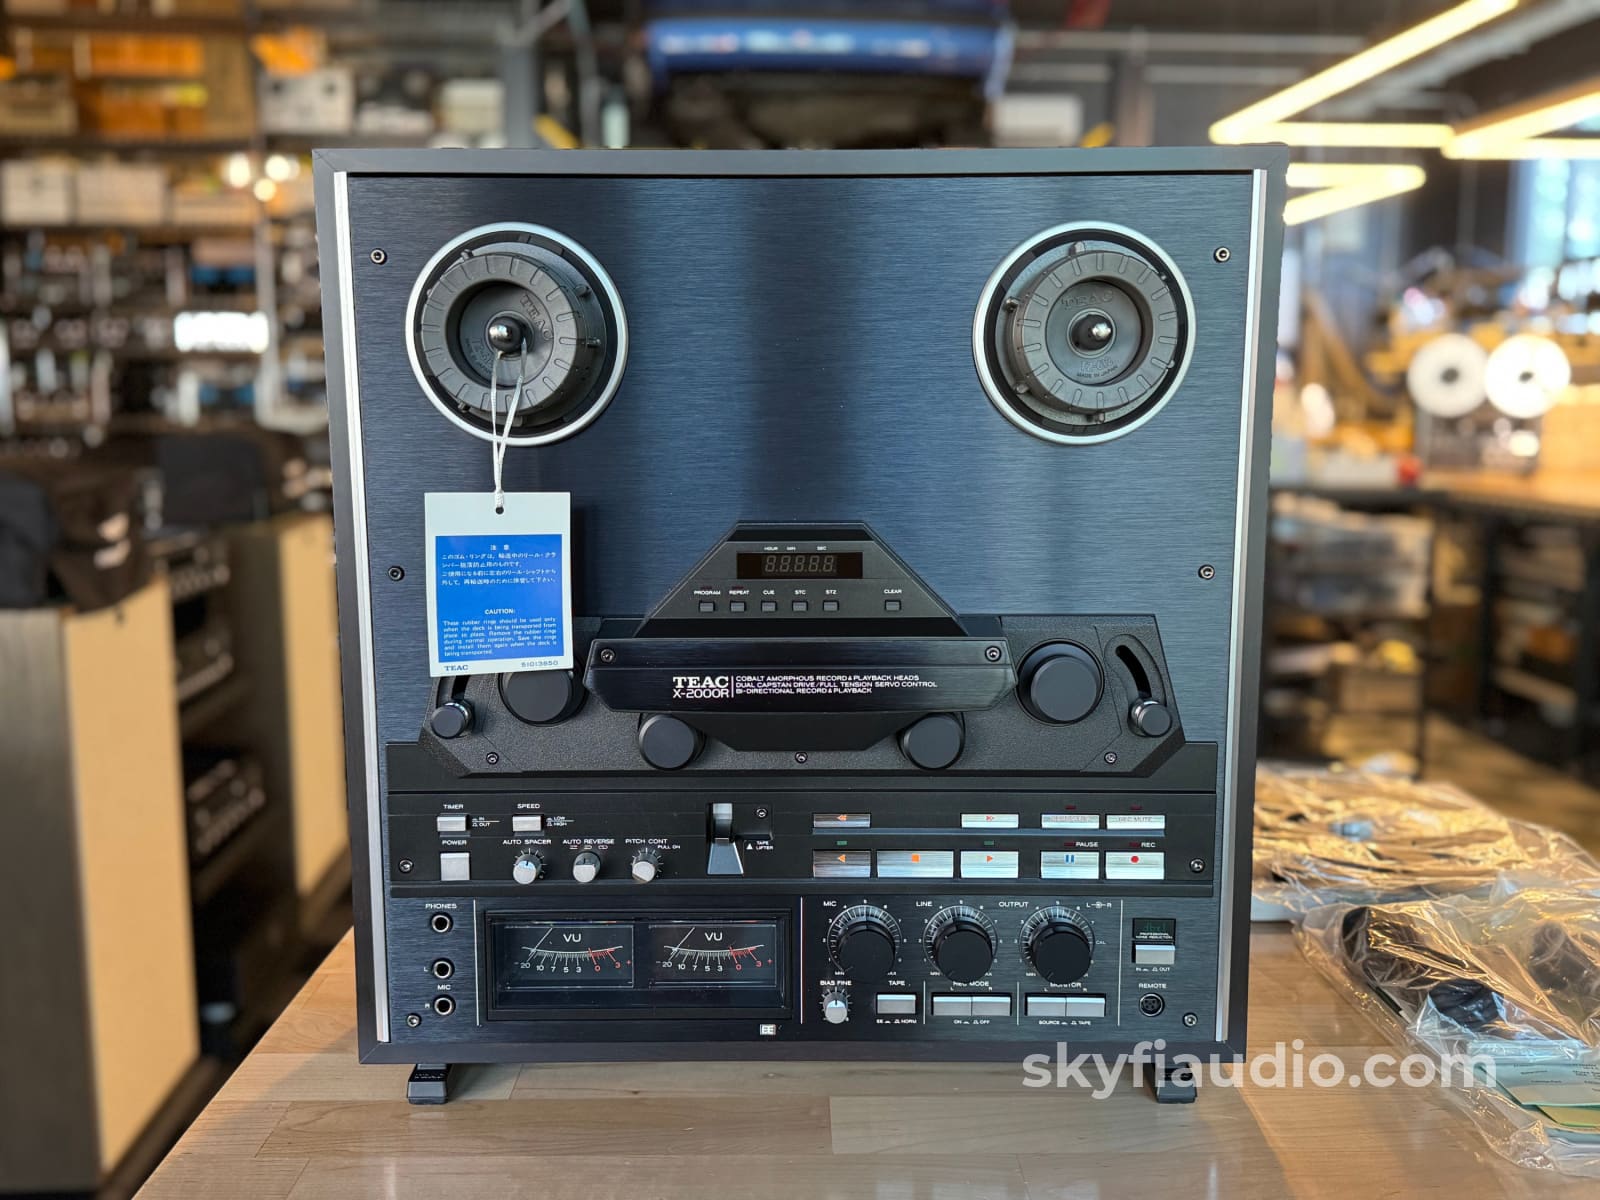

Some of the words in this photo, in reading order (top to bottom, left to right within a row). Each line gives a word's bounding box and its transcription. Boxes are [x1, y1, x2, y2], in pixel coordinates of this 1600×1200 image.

[520, 293, 554, 340] TEAC
[673, 676, 729, 688] TEAC
[673, 688, 729, 698] X-2000R
[563, 934, 581, 942] VU
[705, 932, 723, 941] VU
